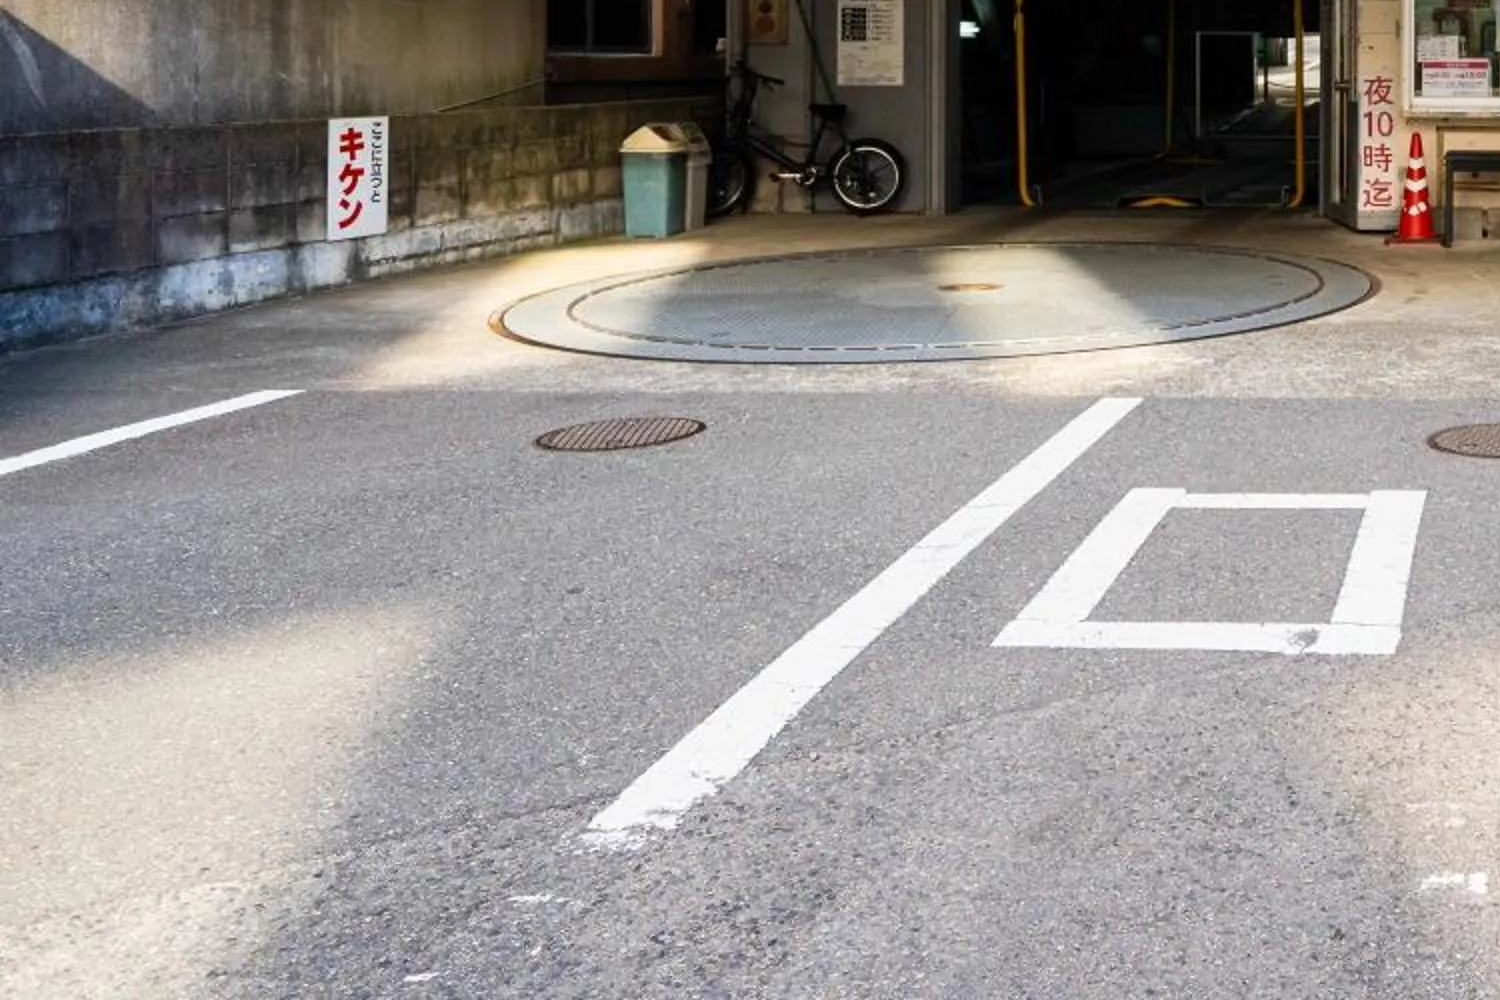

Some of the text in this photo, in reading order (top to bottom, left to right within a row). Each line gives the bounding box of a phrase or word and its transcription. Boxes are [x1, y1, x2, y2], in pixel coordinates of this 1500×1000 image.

[339, 127, 365, 229] キケン
[1363, 75, 1394, 207] 夜10時迄
